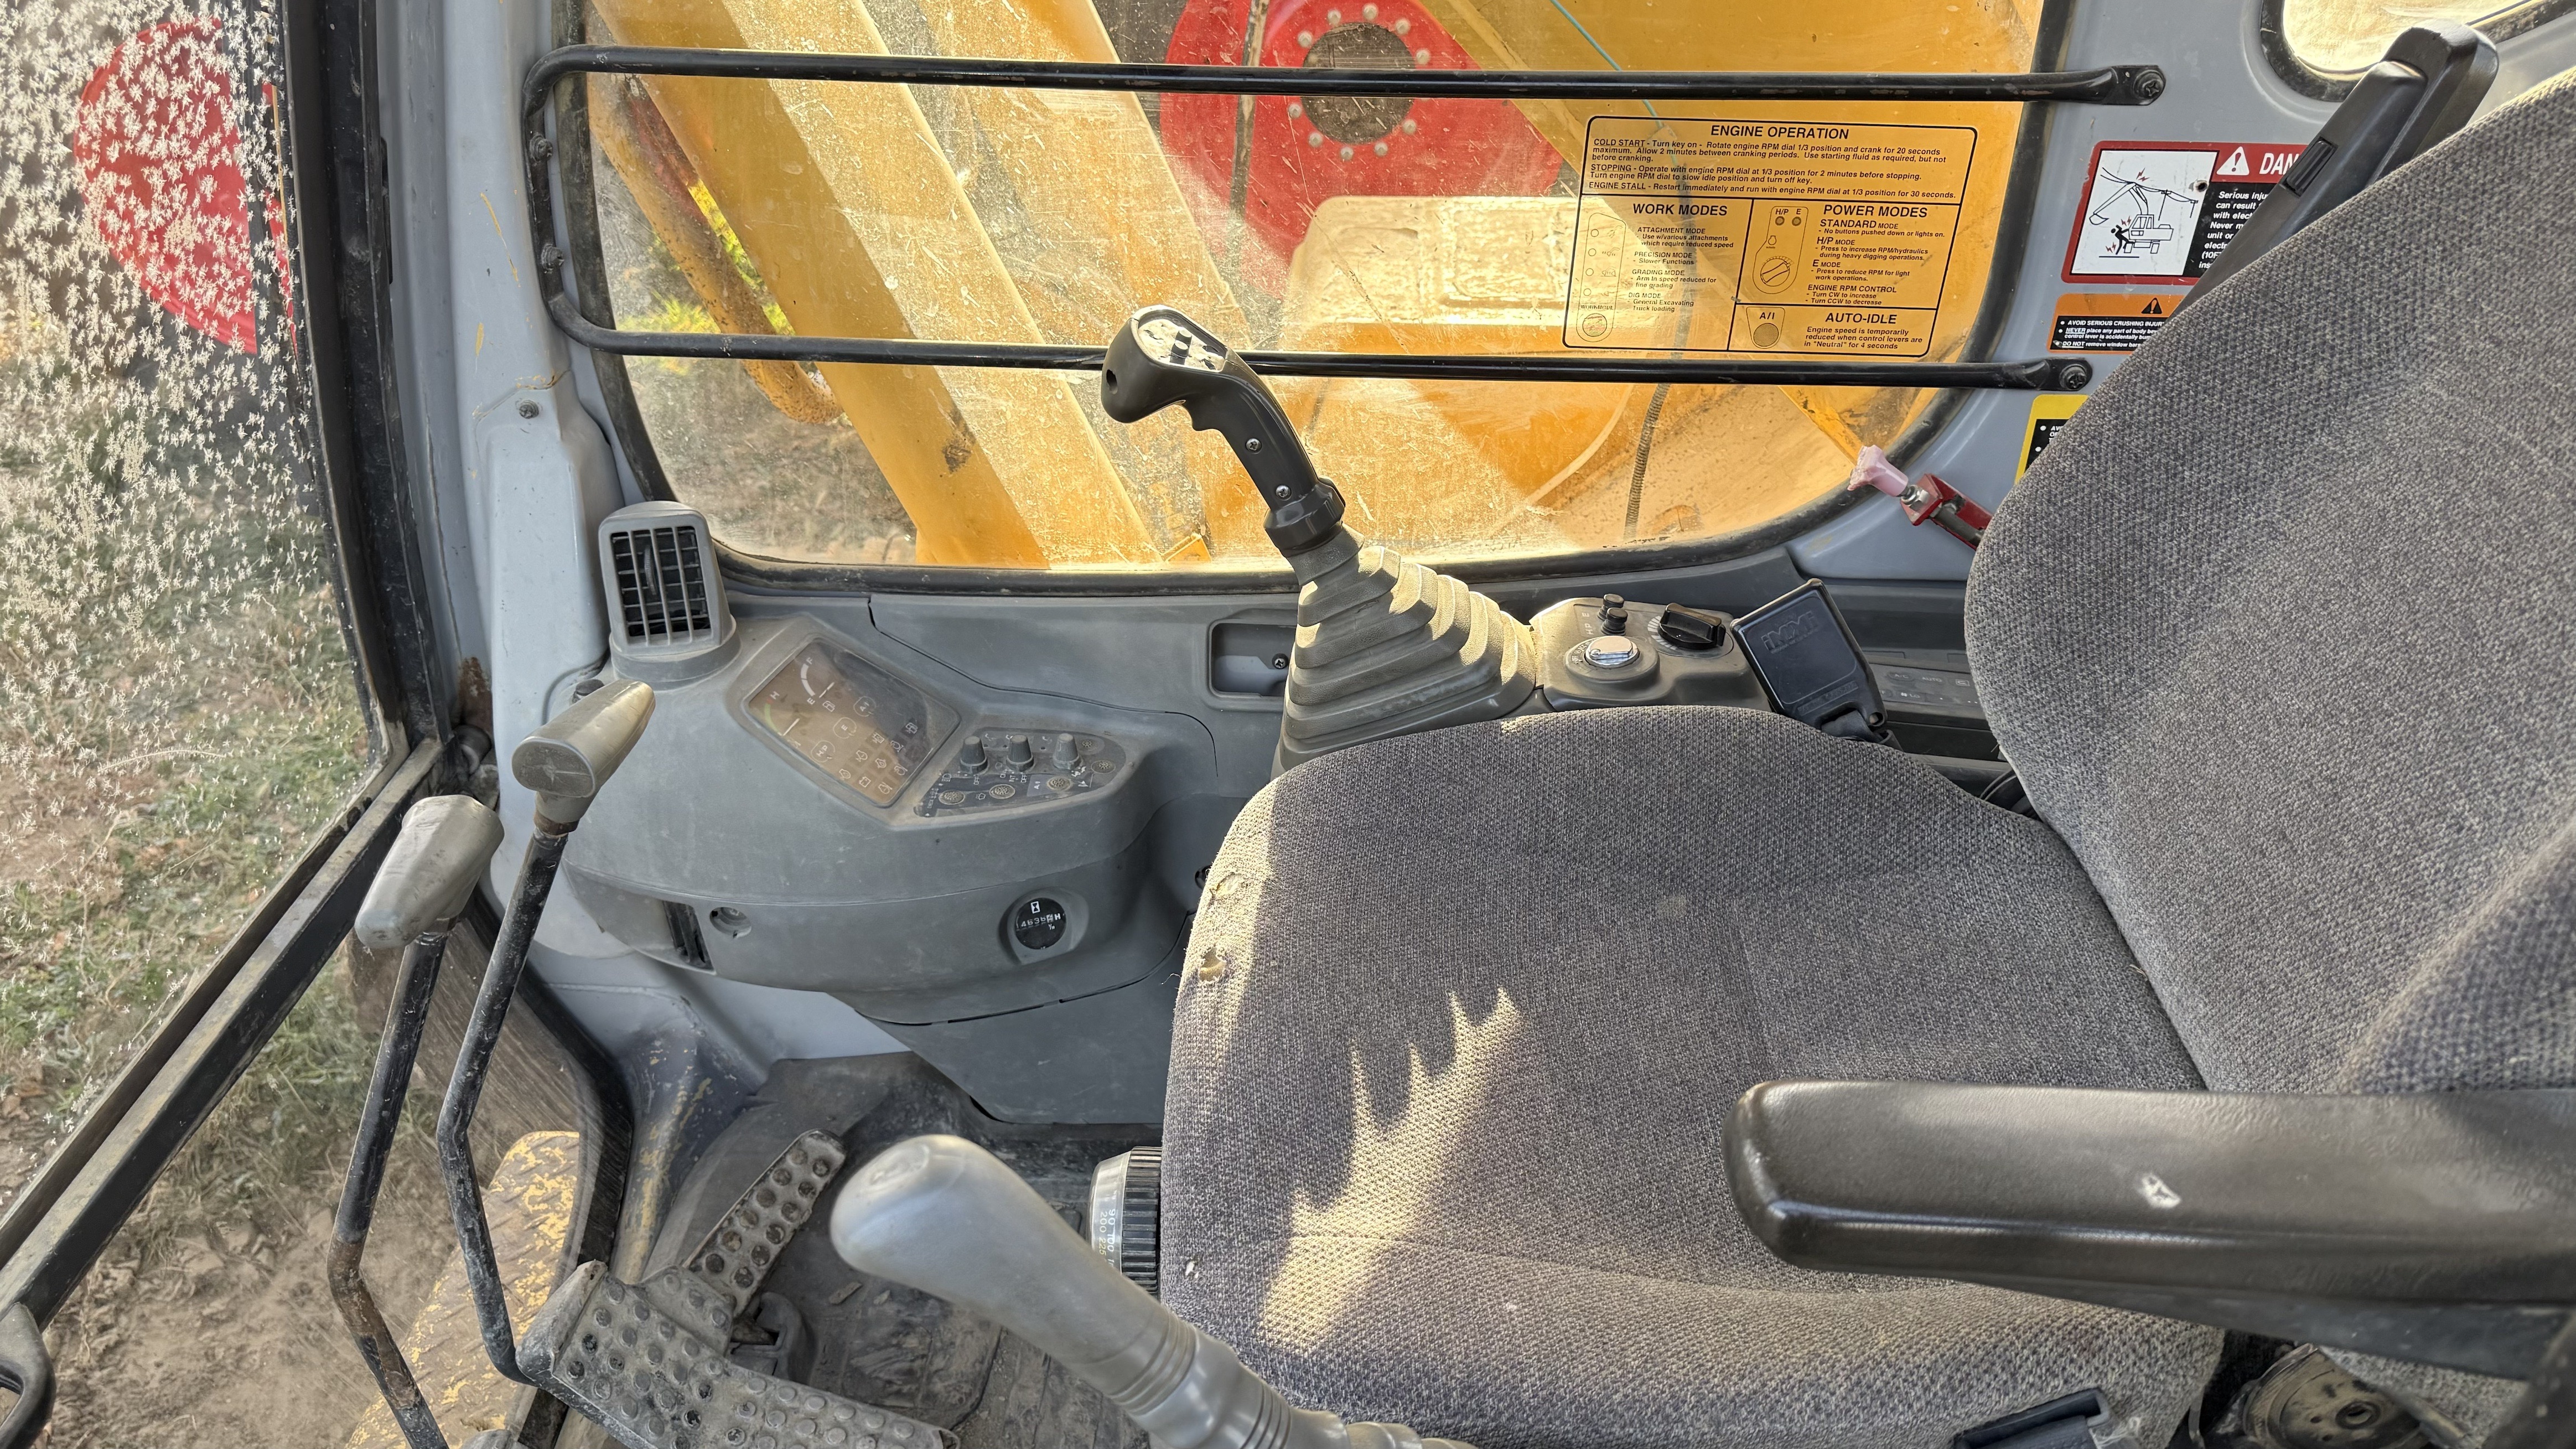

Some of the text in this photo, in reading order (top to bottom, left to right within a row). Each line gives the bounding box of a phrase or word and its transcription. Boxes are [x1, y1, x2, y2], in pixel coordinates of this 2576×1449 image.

[1711, 126, 1849, 139] ENGINE OPERATION
[1672, 141, 1685, 149] key
[1733, 143, 1759, 152] engine
[1810, 145, 1842, 154] position
[1618, 154, 1653, 163] cranking.
[1733, 151, 1766, 159] cranking
[1768, 152, 1799, 160] periods.
[1821, 153, 1851, 162] starting
[1883, 154, 1916, 163] required,
[2259, 153, 2300, 175] DAN
[1609, 172, 1635, 180] engine
[1717, 175, 1749, 183] position
[1639, 165, 1668, 174] Operate
[1688, 167, 1714, 175] engine
[1774, 169, 1806, 178] position
[1886, 172, 1921, 181] stopping.
[1682, 184, 1728, 193] immediately
[1779, 187, 1805, 195] engine
[1864, 189, 1896, 198] position
[1632, 204, 1728, 216] WORK MODES
[1823, 205, 1928, 218] POWER MODES
[1820, 220, 1877, 229] STANDARD
[1826, 313, 1897, 324] AUTO-IDLE
[1867, 328, 1909, 337] temporarily
[770, 691, 780, 700] H
[1108, 1208, 1116, 1225] 90
